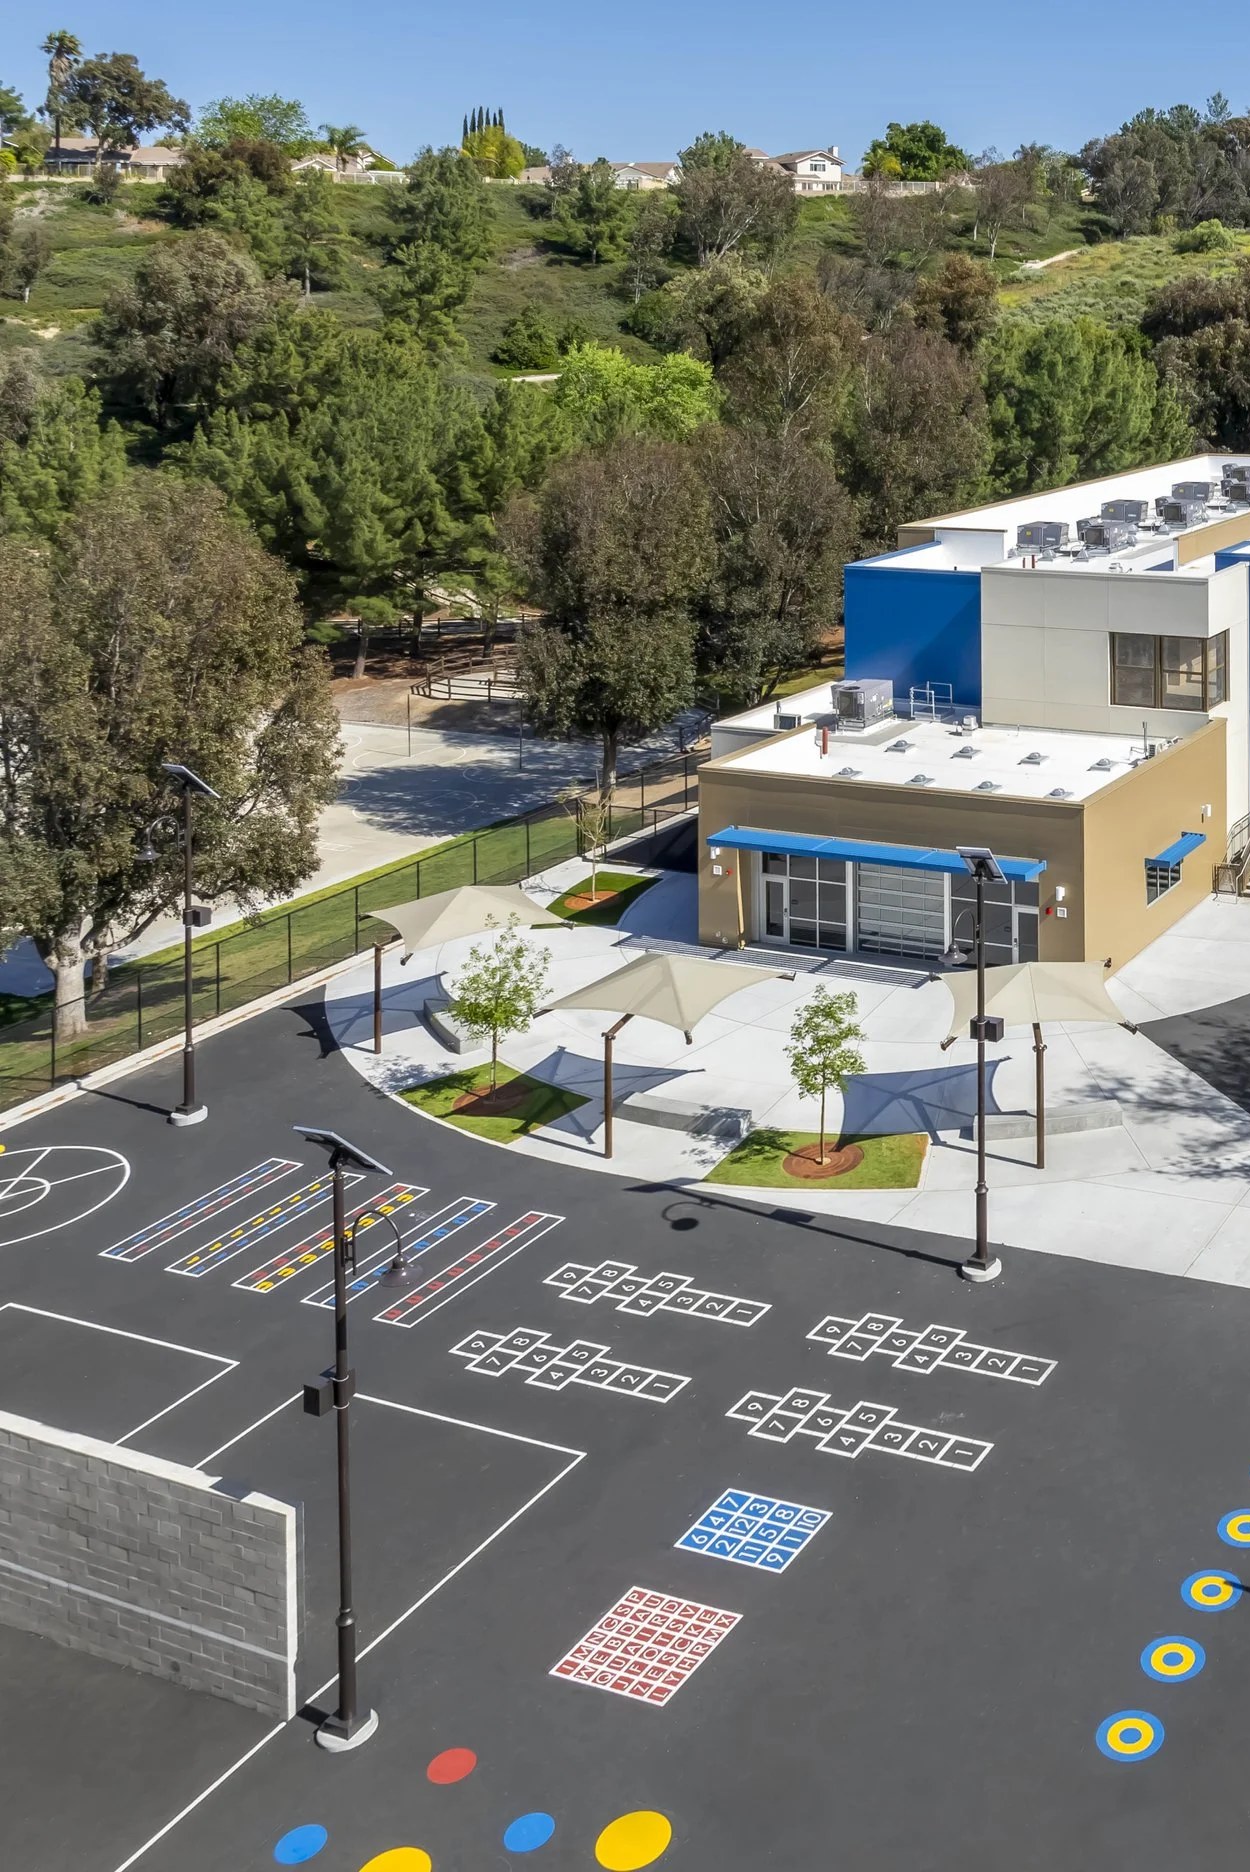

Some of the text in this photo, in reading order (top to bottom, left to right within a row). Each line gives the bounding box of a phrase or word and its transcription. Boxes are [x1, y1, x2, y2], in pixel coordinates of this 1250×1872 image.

[562, 1271, 577, 1279] 9
[577, 1269, 619, 1295] 7 8
[621, 1284, 636, 1292] 6
[638, 1280, 675, 1308] 4 5
[676, 1296, 694, 1305] 3
[705, 1301, 724, 1311] 2
[825, 1325, 841, 1334] 9
[846, 1322, 884, 1351] 7 8
[891, 1338, 907, 1347] 6
[470, 1340, 486, 1349] 9
[485, 1337, 530, 1366] 7 8
[913, 1333, 948, 1364] 4 5
[954, 1351, 973, 1361] 3
[532, 1354, 548, 1363] 6
[549, 1349, 589, 1380] 4 5
[987, 1357, 1007, 1368] 2
[590, 1368, 609, 1378] 3
[620, 1374, 641, 1385] 2
[747, 1402, 764, 1411] 9
[768, 1398, 810, 1431] 7 8
[816, 1417, 833, 1427] 6
[839, 1412, 877, 1447] 4 5
[883, 1432, 903, 1443] 3
[918, 1439, 939, 1451] 2
[691, 1497, 738, 1544] 6 4 7
[715, 1503, 768, 1552] 2 12 3
[739, 1509, 794, 1558] 11 5 8
[766, 1553, 784, 1563] 9
[797, 1512, 822, 1528] 10
[573, 1646, 594, 1660] M
[588, 1632, 605, 1644] N
[602, 1619, 618, 1630] G
[628, 1593, 640, 1602] P
[575, 1597, 661, 1679] W E B D A U
[596, 1672, 614, 1684] Q
[610, 1658, 626, 1668] U
[627, 1645, 641, 1655] A
[651, 1616, 666, 1625] R
[663, 1602, 678, 1612] D
[617, 1680, 629, 1688] J
[629, 1664, 641, 1673] F
[643, 1648, 658, 1660] O
[669, 1621, 683, 1630] S
[681, 1606, 695, 1615] V
[634, 1612, 715, 1693] Z E S C K E
[665, 1673, 680, 1681] Y
[679, 1658, 696, 1669] H
[692, 1645, 709, 1654] R
[704, 1629, 724, 1642] M
[717, 1616, 734, 1626] X
